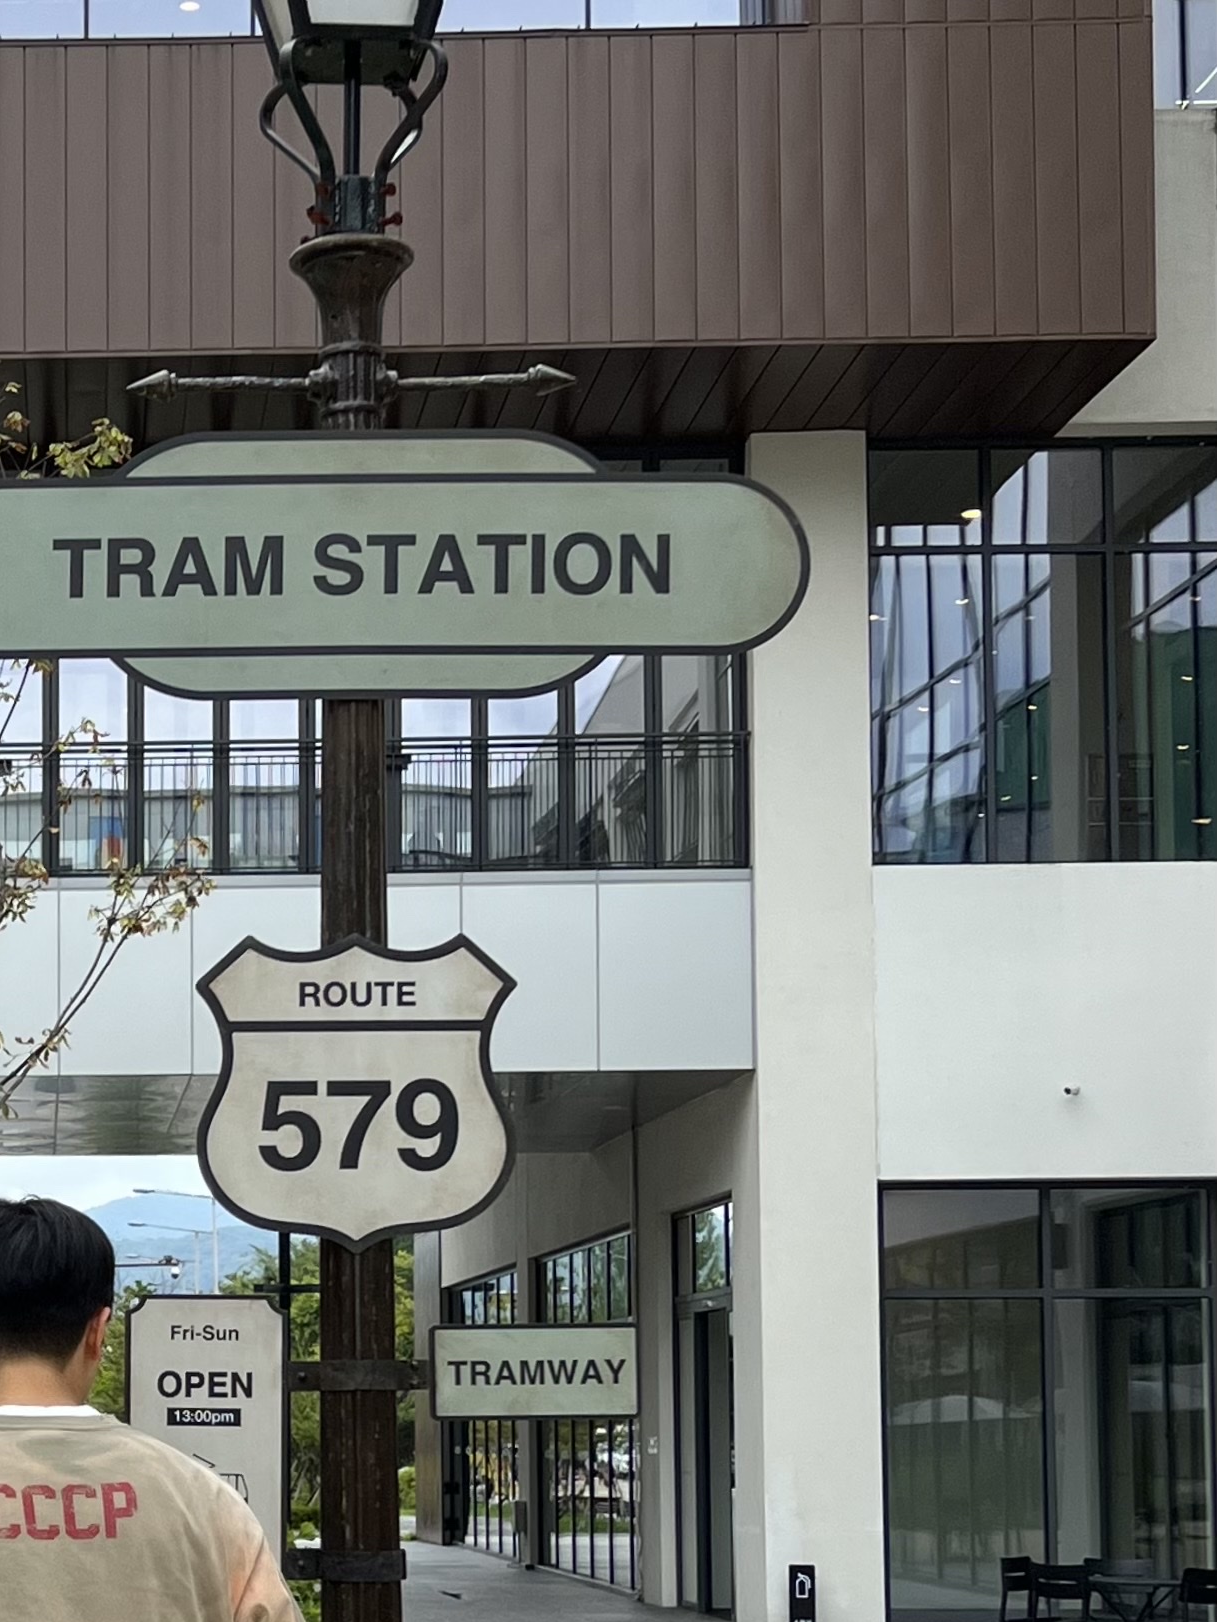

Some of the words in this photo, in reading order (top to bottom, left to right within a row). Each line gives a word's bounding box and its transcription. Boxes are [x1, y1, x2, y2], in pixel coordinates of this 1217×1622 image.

[53, 536, 284, 598] TRAM
[313, 532, 671, 596] STATION
[299, 981, 417, 1008] ROUTE
[258, 1078, 459, 1172] 579
[170, 1324, 240, 1342] Fri-Sun
[157, 1370, 253, 1399] OPEN
[447, 1358, 627, 1386] TRAMWAY
[173, 1409, 235, 1425] 13:00pm
